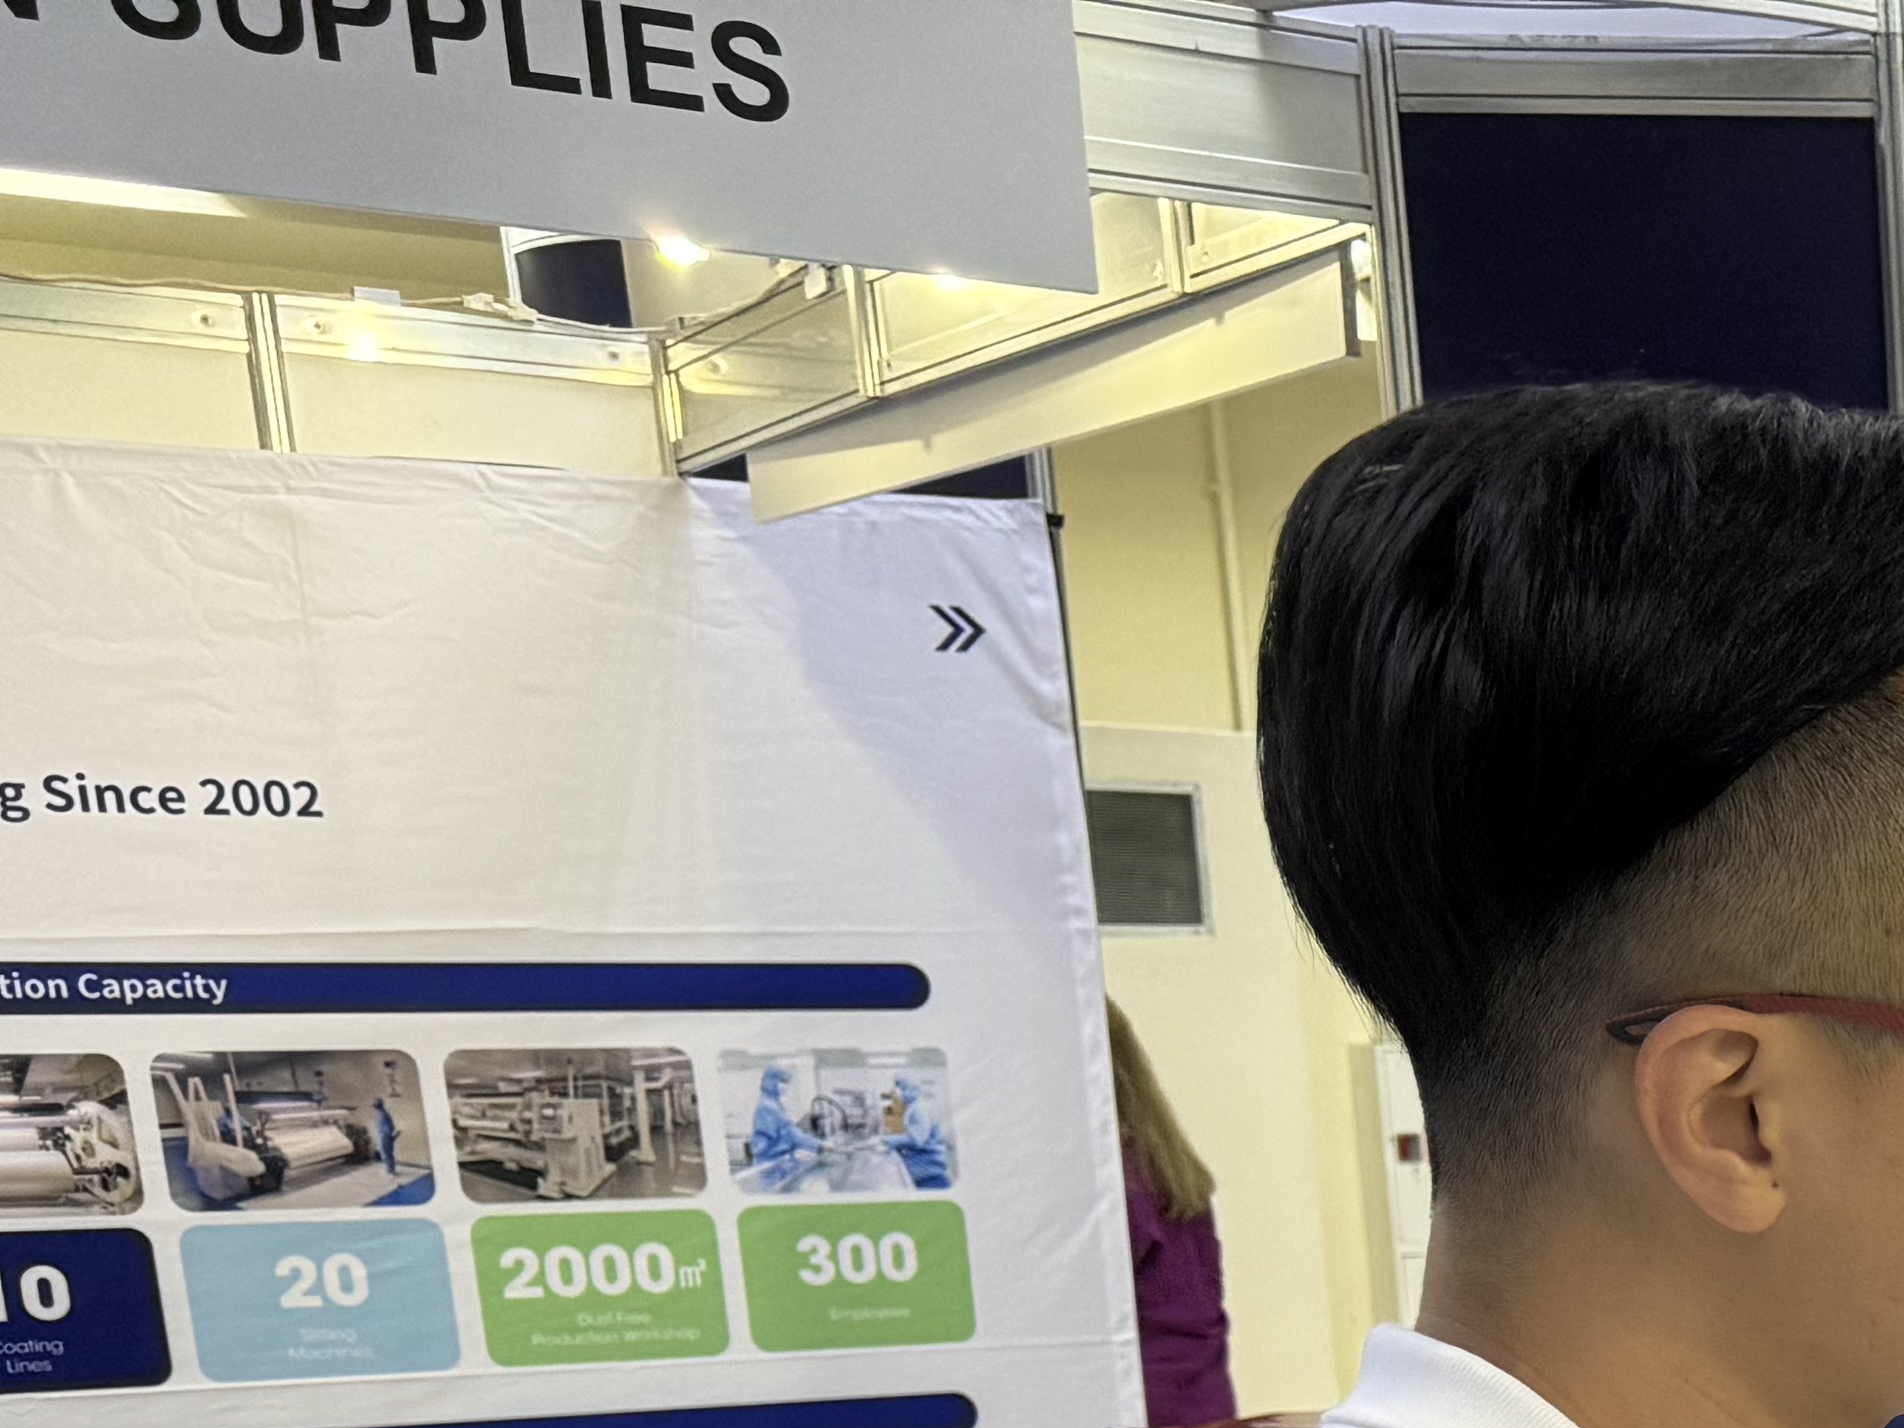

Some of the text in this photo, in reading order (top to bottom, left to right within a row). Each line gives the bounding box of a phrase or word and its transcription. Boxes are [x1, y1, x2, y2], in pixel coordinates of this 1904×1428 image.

[42, 772, 186, 815] Since
[199, 778, 324, 818] 2002
[77, 972, 228, 1005] Capacity
[275, 1252, 369, 1309] 20
[797, 1232, 918, 1286] 300
[7, 1358, 53, 1374] Lines
